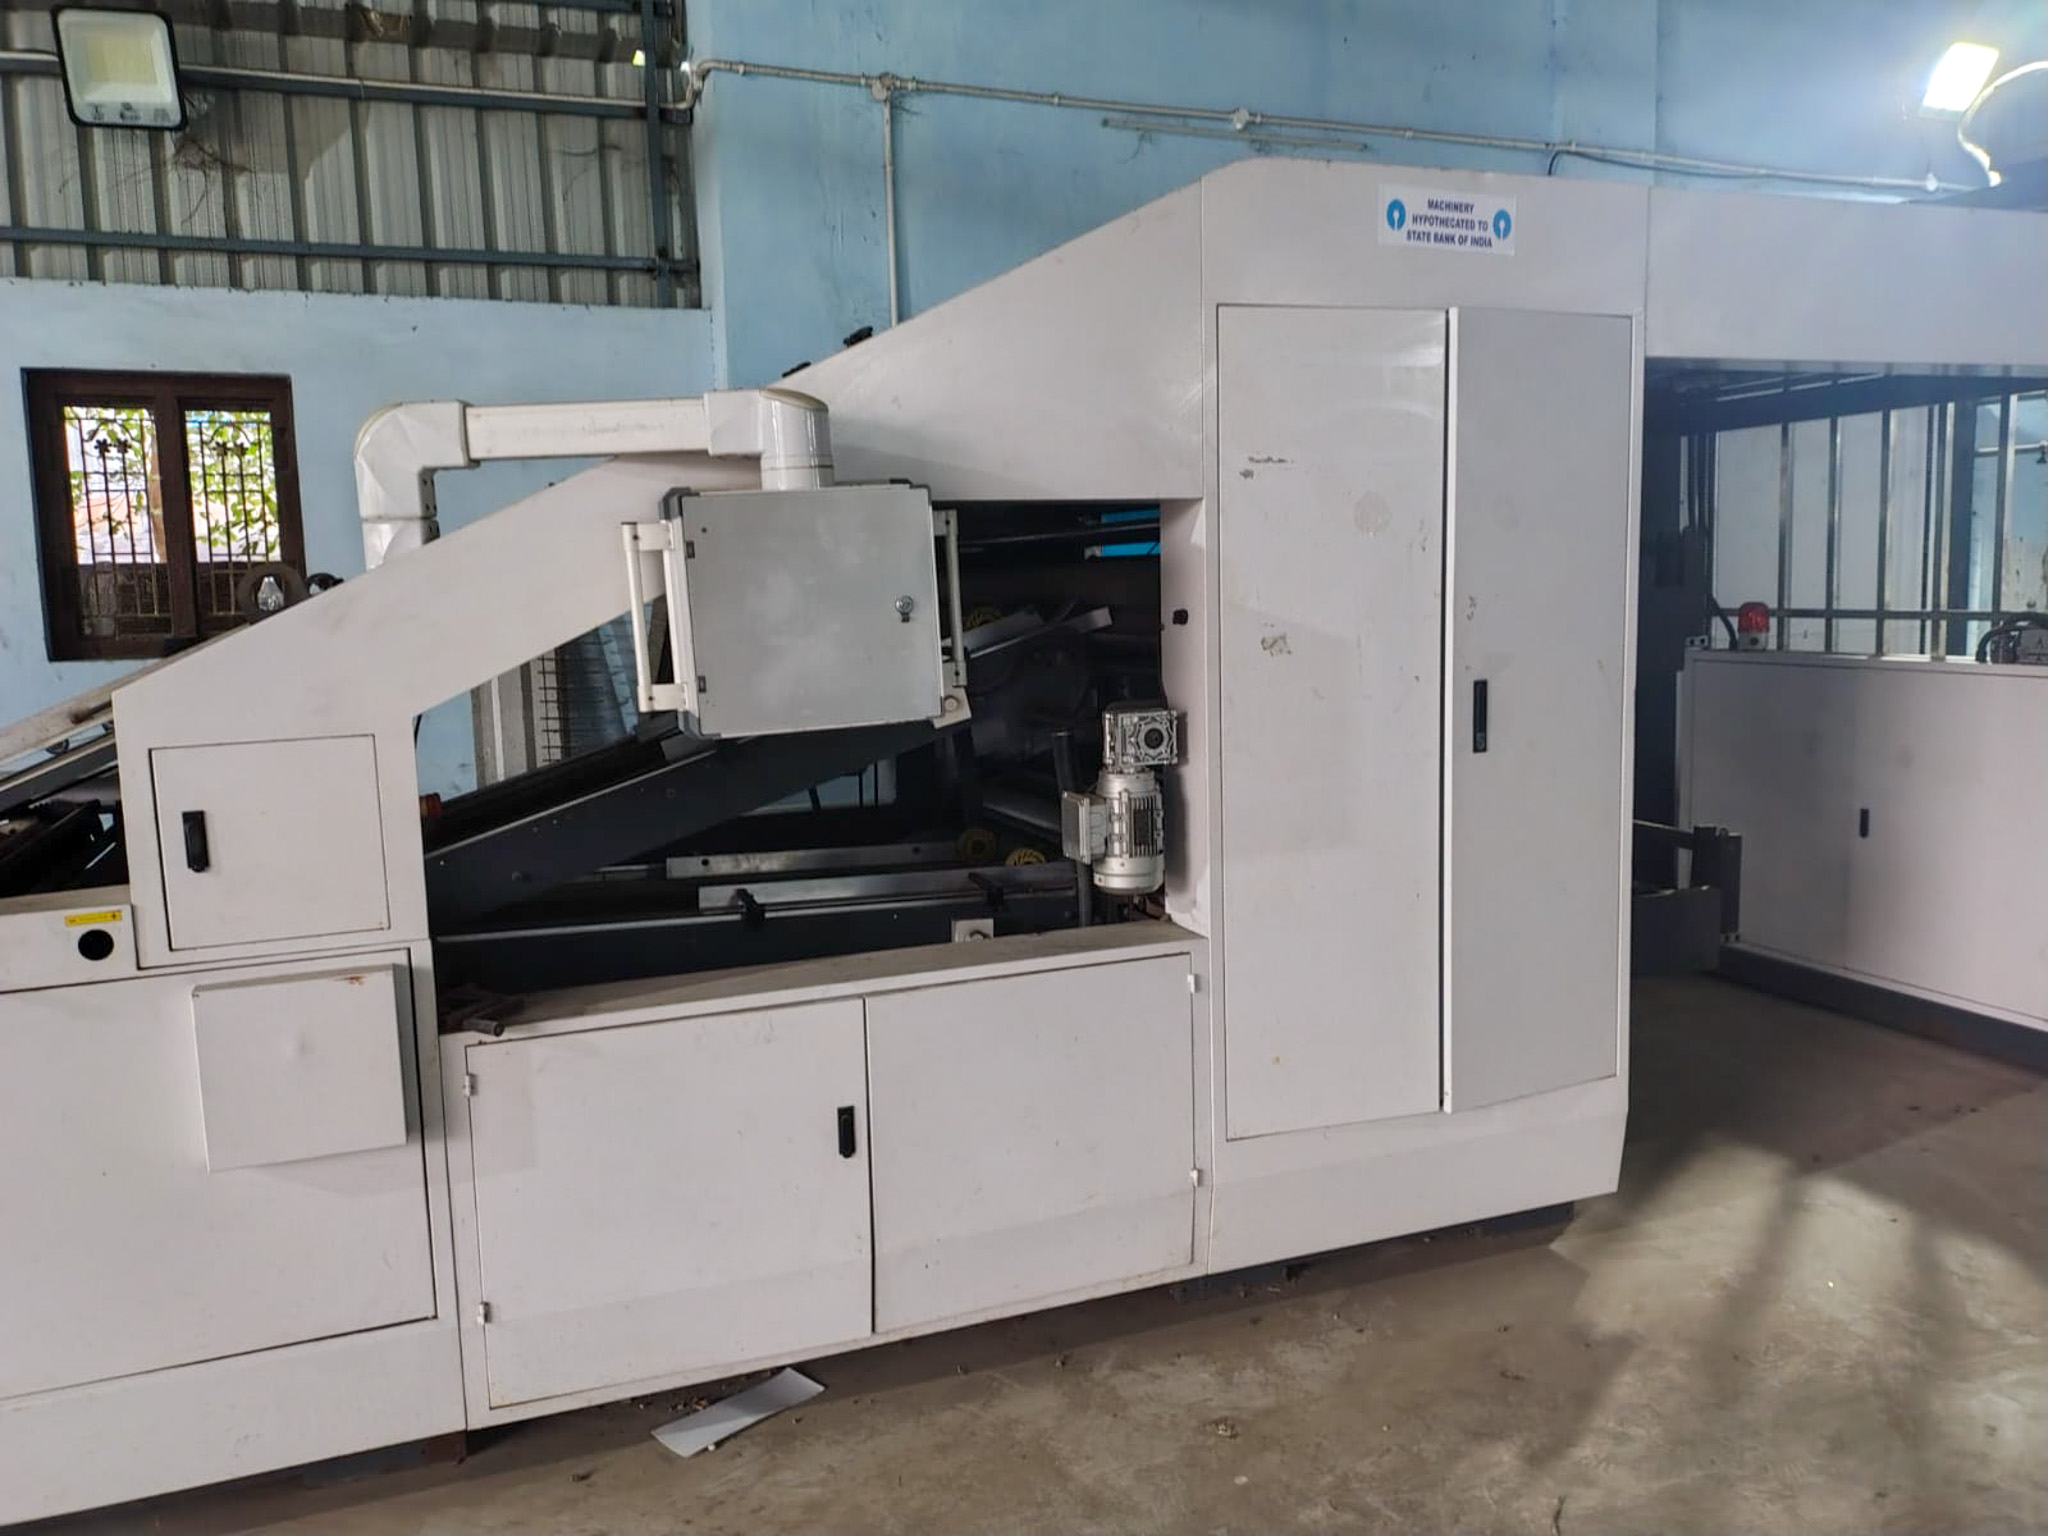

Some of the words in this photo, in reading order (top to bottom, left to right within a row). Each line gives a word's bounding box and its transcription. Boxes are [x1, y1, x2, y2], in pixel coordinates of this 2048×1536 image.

[1427, 198, 1475, 214] MACHINERY
[1412, 214, 1475, 230] HYPOTHECATED
[1478, 220, 1488, 231] TO
[1406, 230, 1431, 243] STATE
[1433, 233, 1455, 245] BANK
[1457, 235, 1468, 246] OF
[1470, 235, 1493, 248] INDIA
